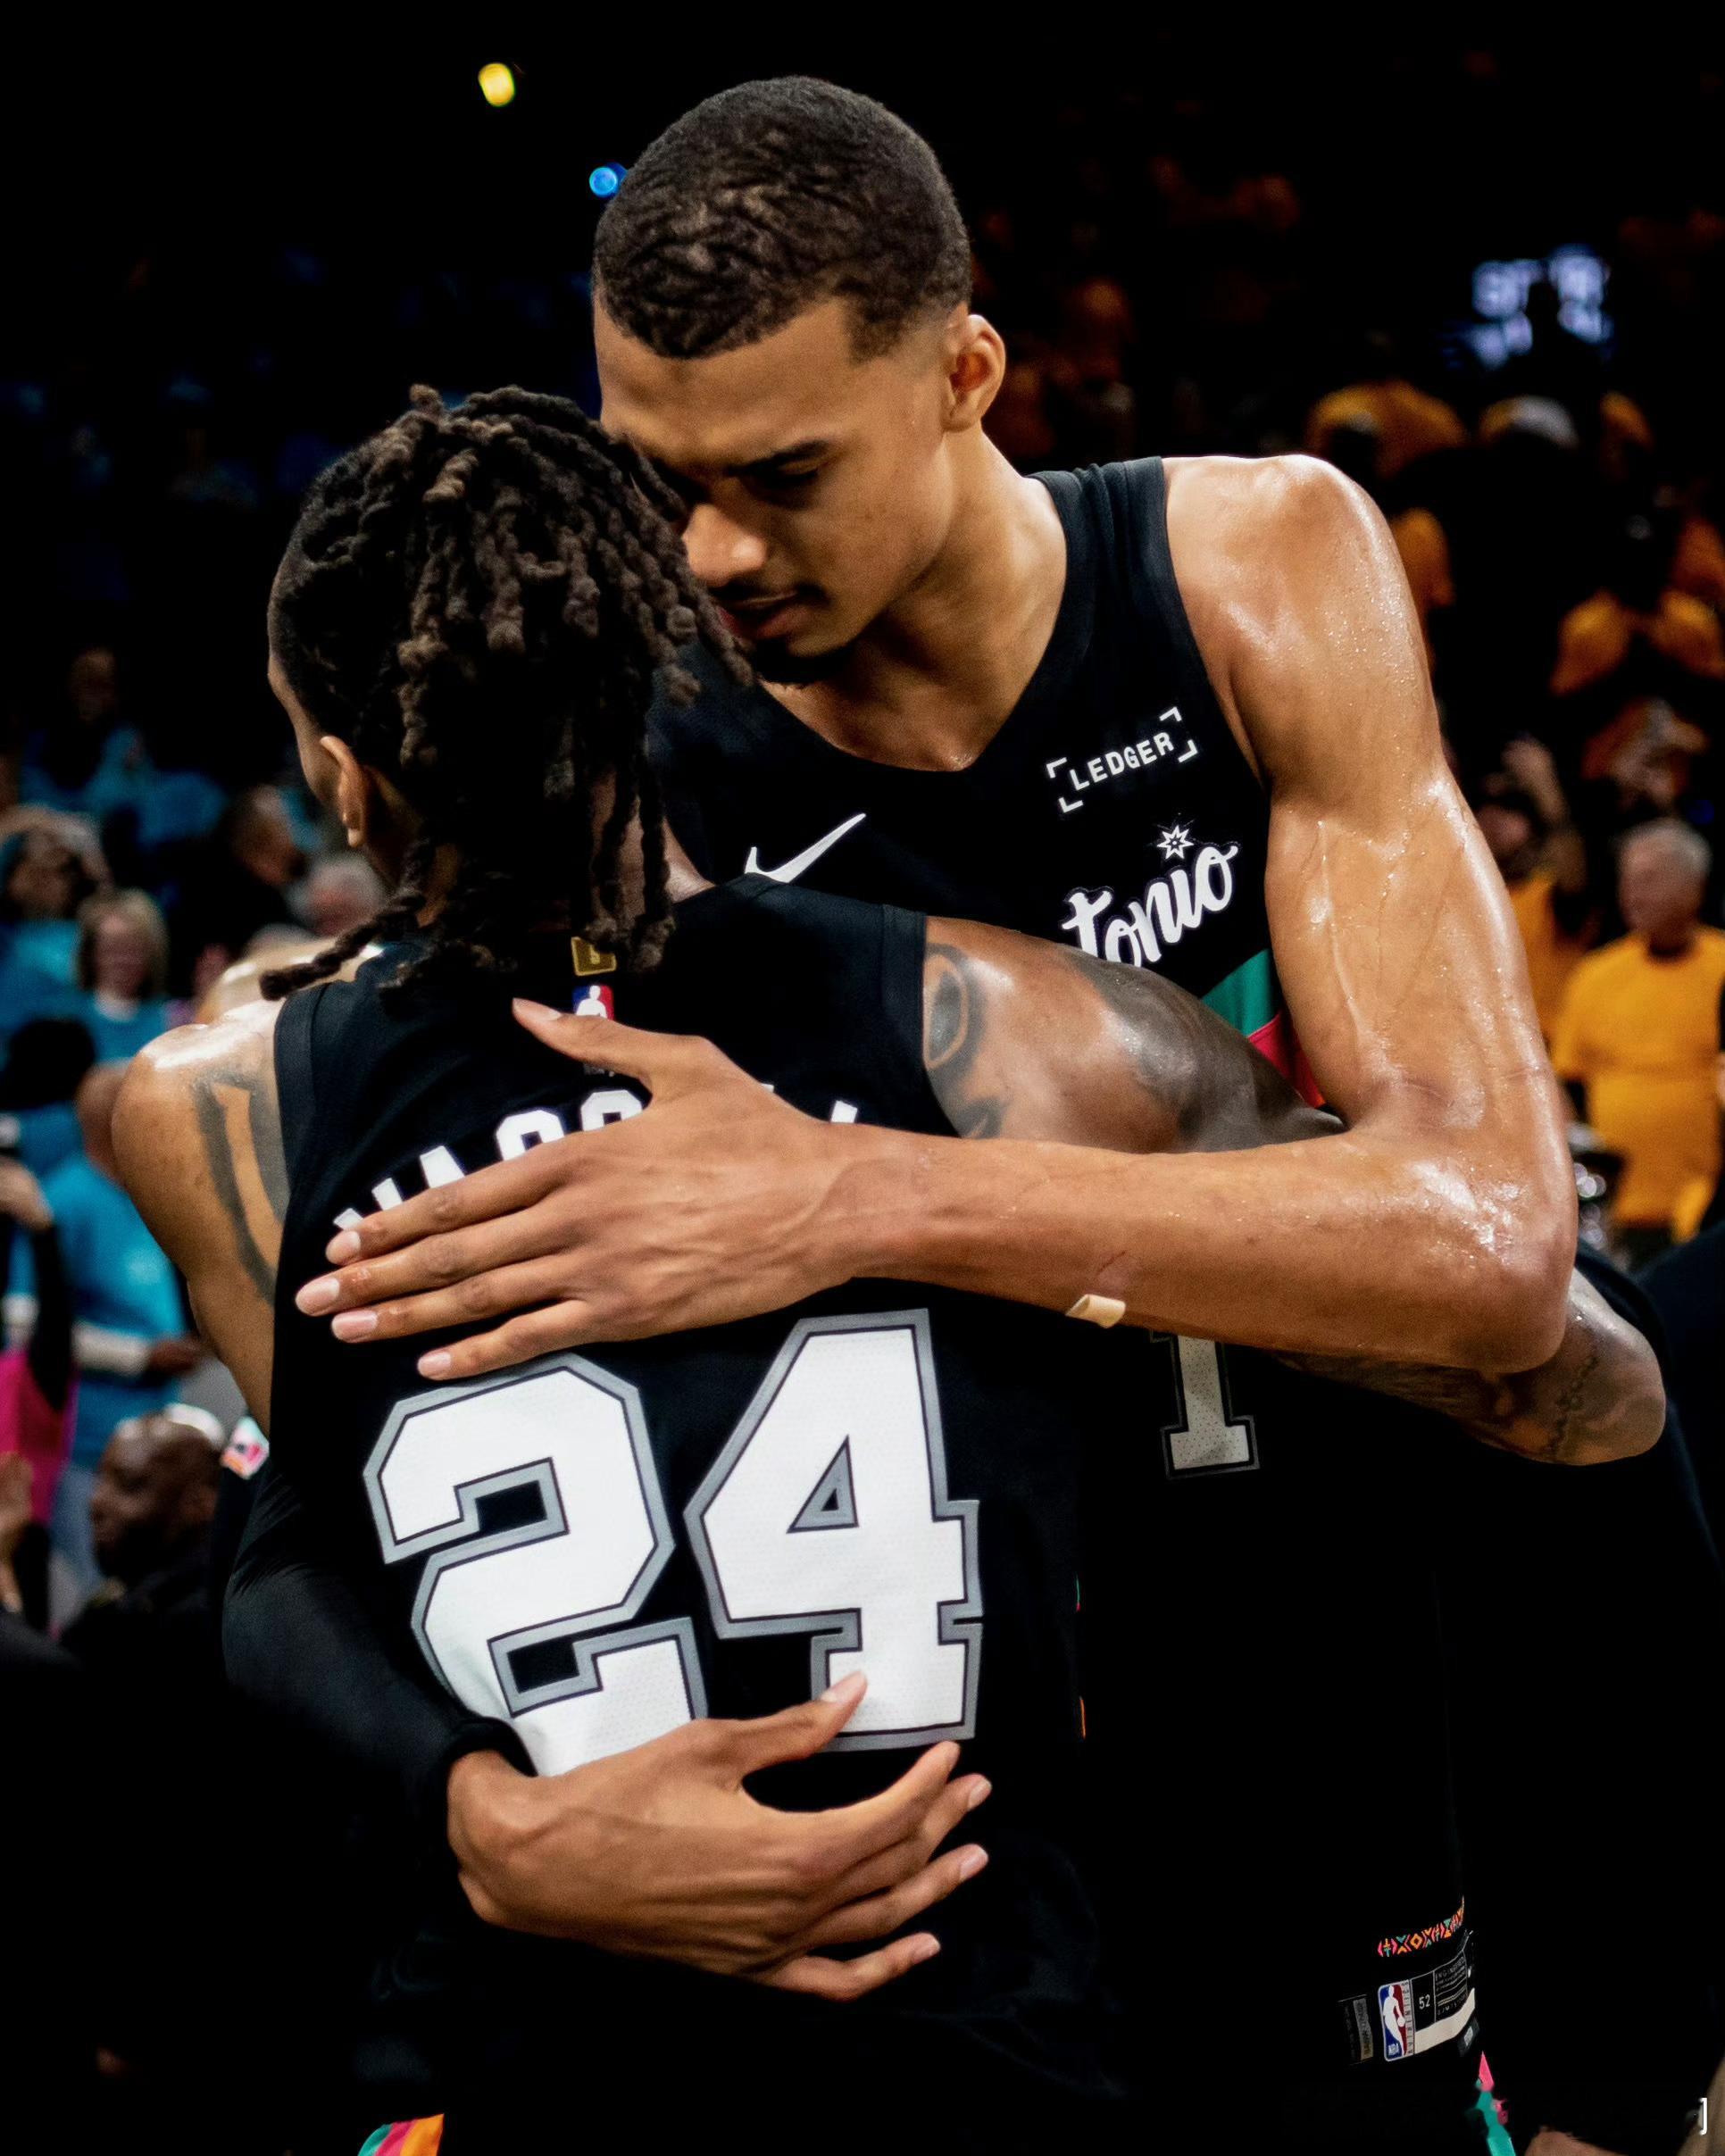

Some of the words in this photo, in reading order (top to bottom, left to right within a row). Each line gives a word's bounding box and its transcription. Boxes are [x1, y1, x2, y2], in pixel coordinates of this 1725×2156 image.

[1070, 731, 1175, 790] LEDGER
[362, 1308, 984, 1778] 24
[1419, 1994, 1430, 2010] 52
